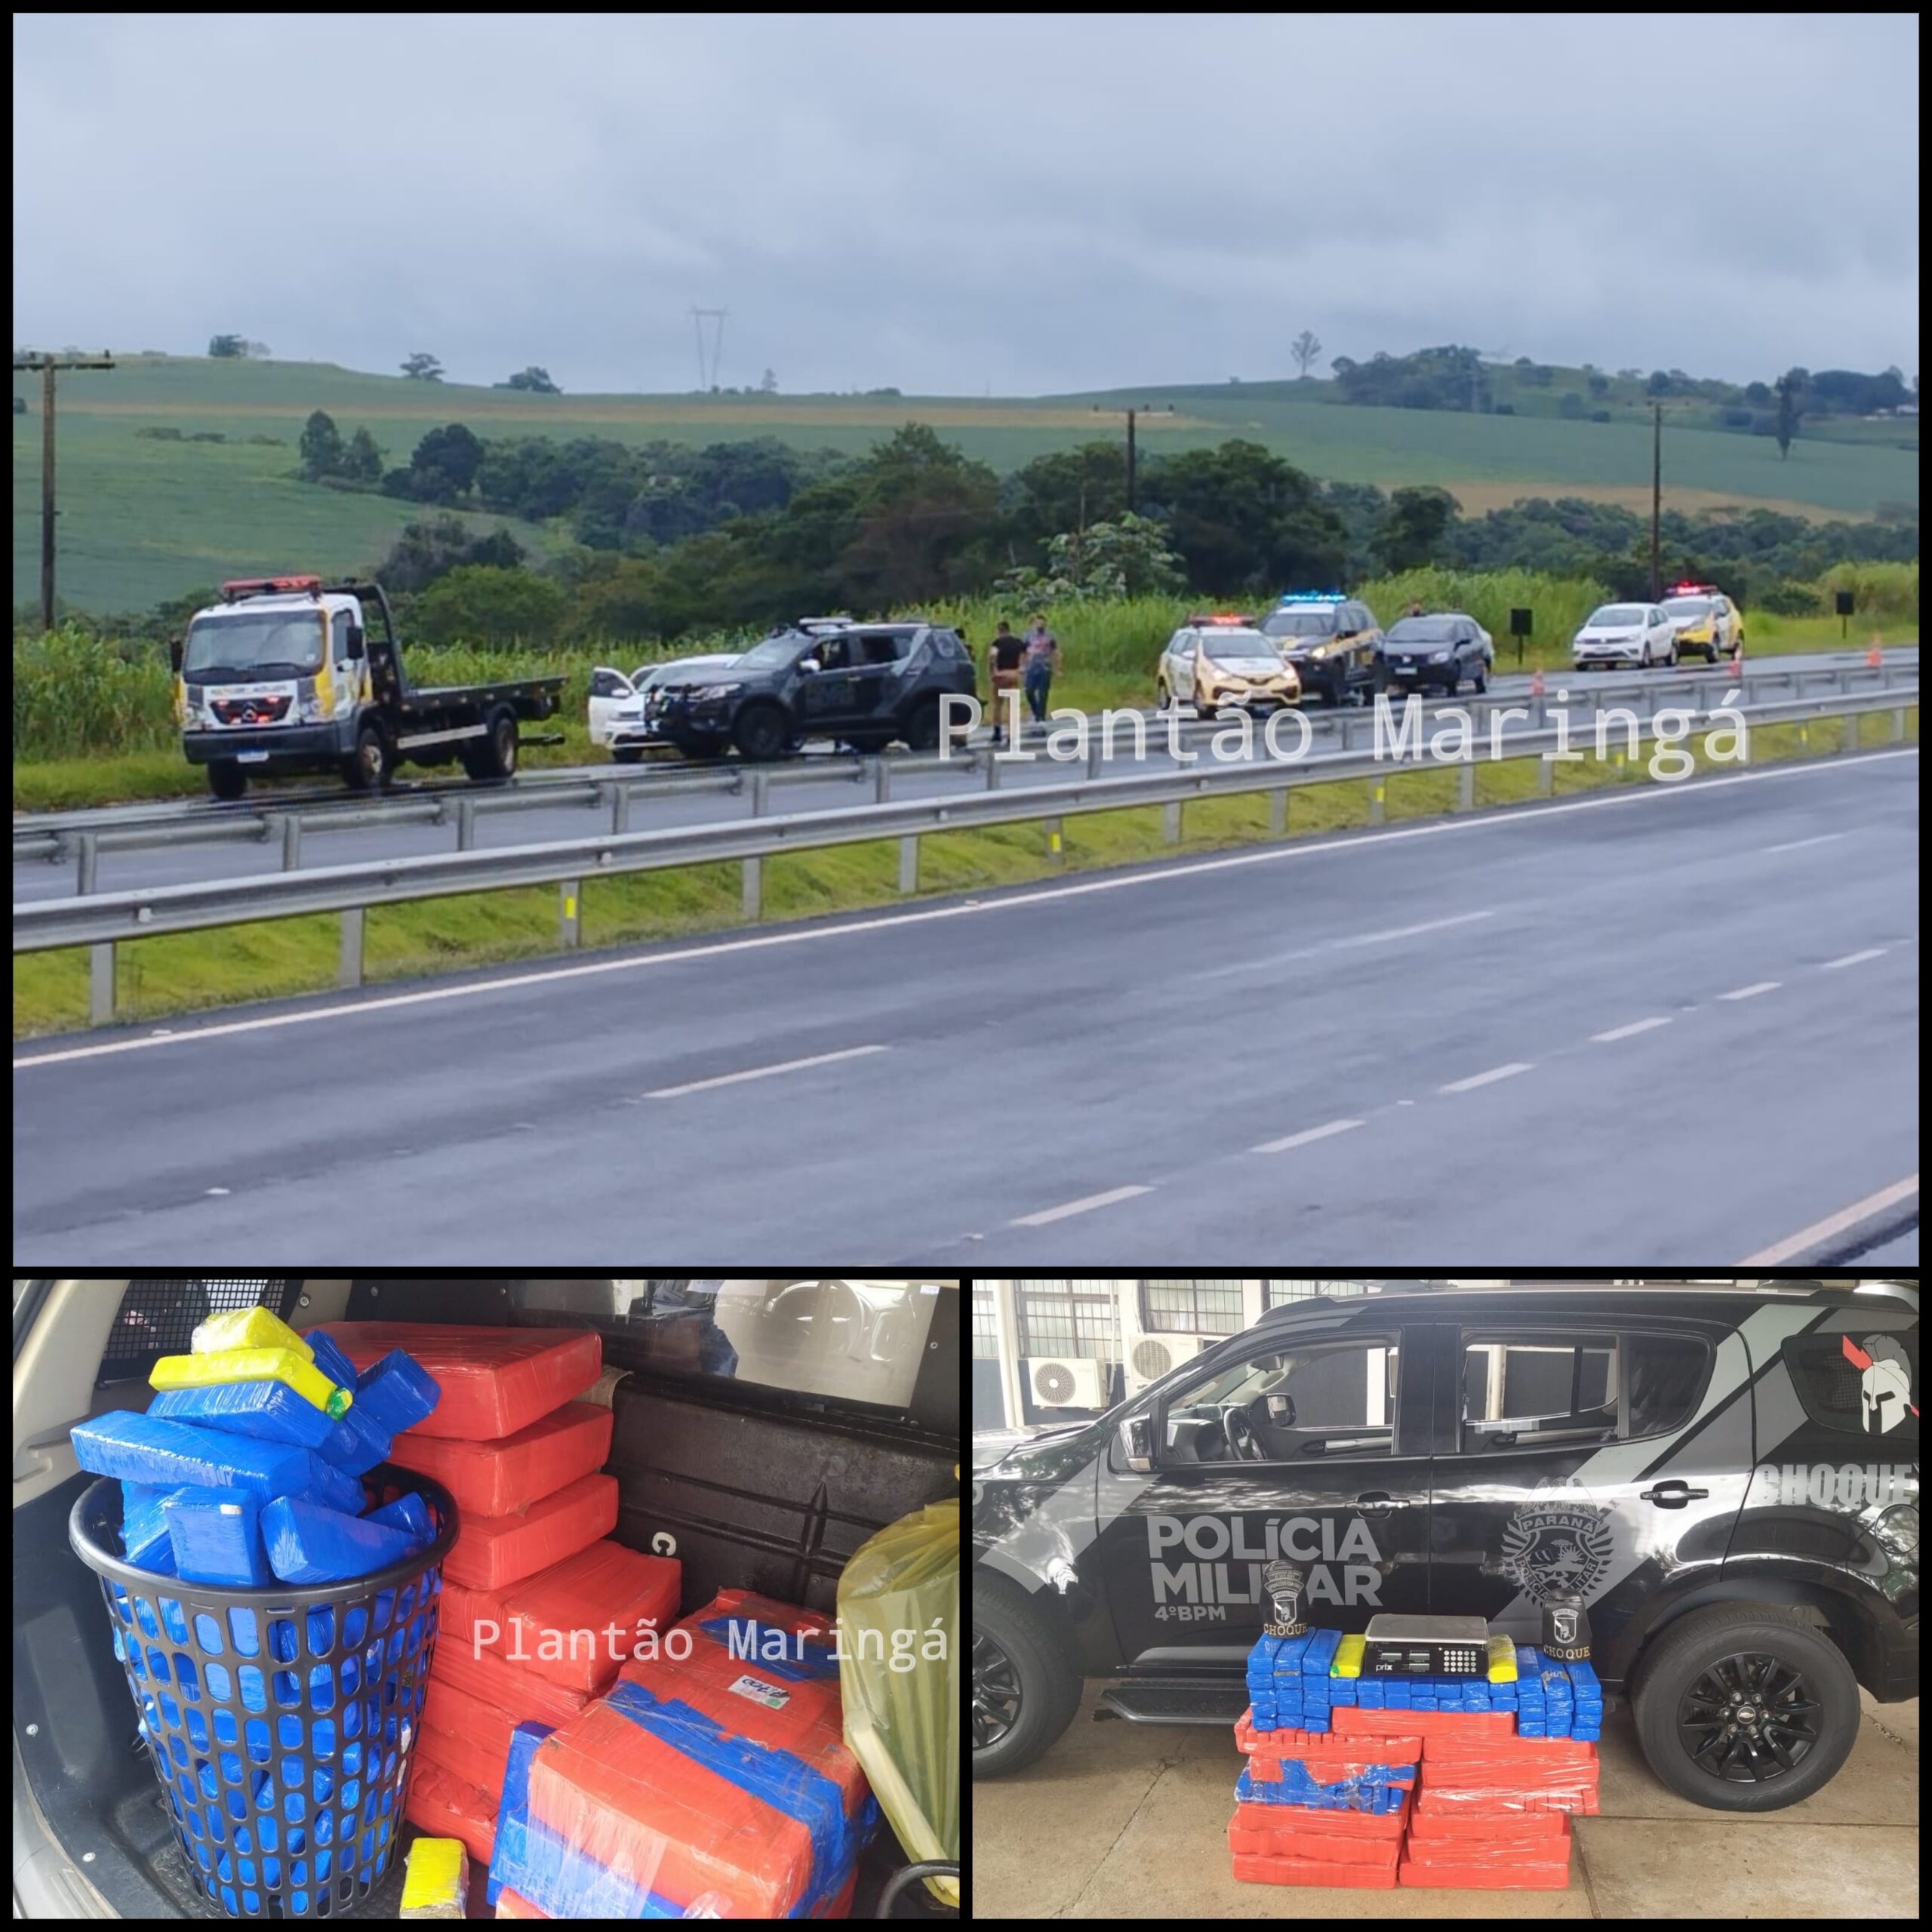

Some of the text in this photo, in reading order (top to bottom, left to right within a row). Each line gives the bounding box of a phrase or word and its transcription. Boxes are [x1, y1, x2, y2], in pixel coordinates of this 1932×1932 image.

[1754, 1463, 1912, 1509] CHOQUE
[1522, 1515, 1595, 1533] PARANÁ
[1146, 1515, 1383, 1561] POLÍCIA
[1150, 1562, 1383, 1606] MILIAR
[1263, 1623, 1308, 1636] CHOQUE
[1543, 1645, 1590, 1660] CHOQUE
[1376, 1663, 1393, 1672] prix
